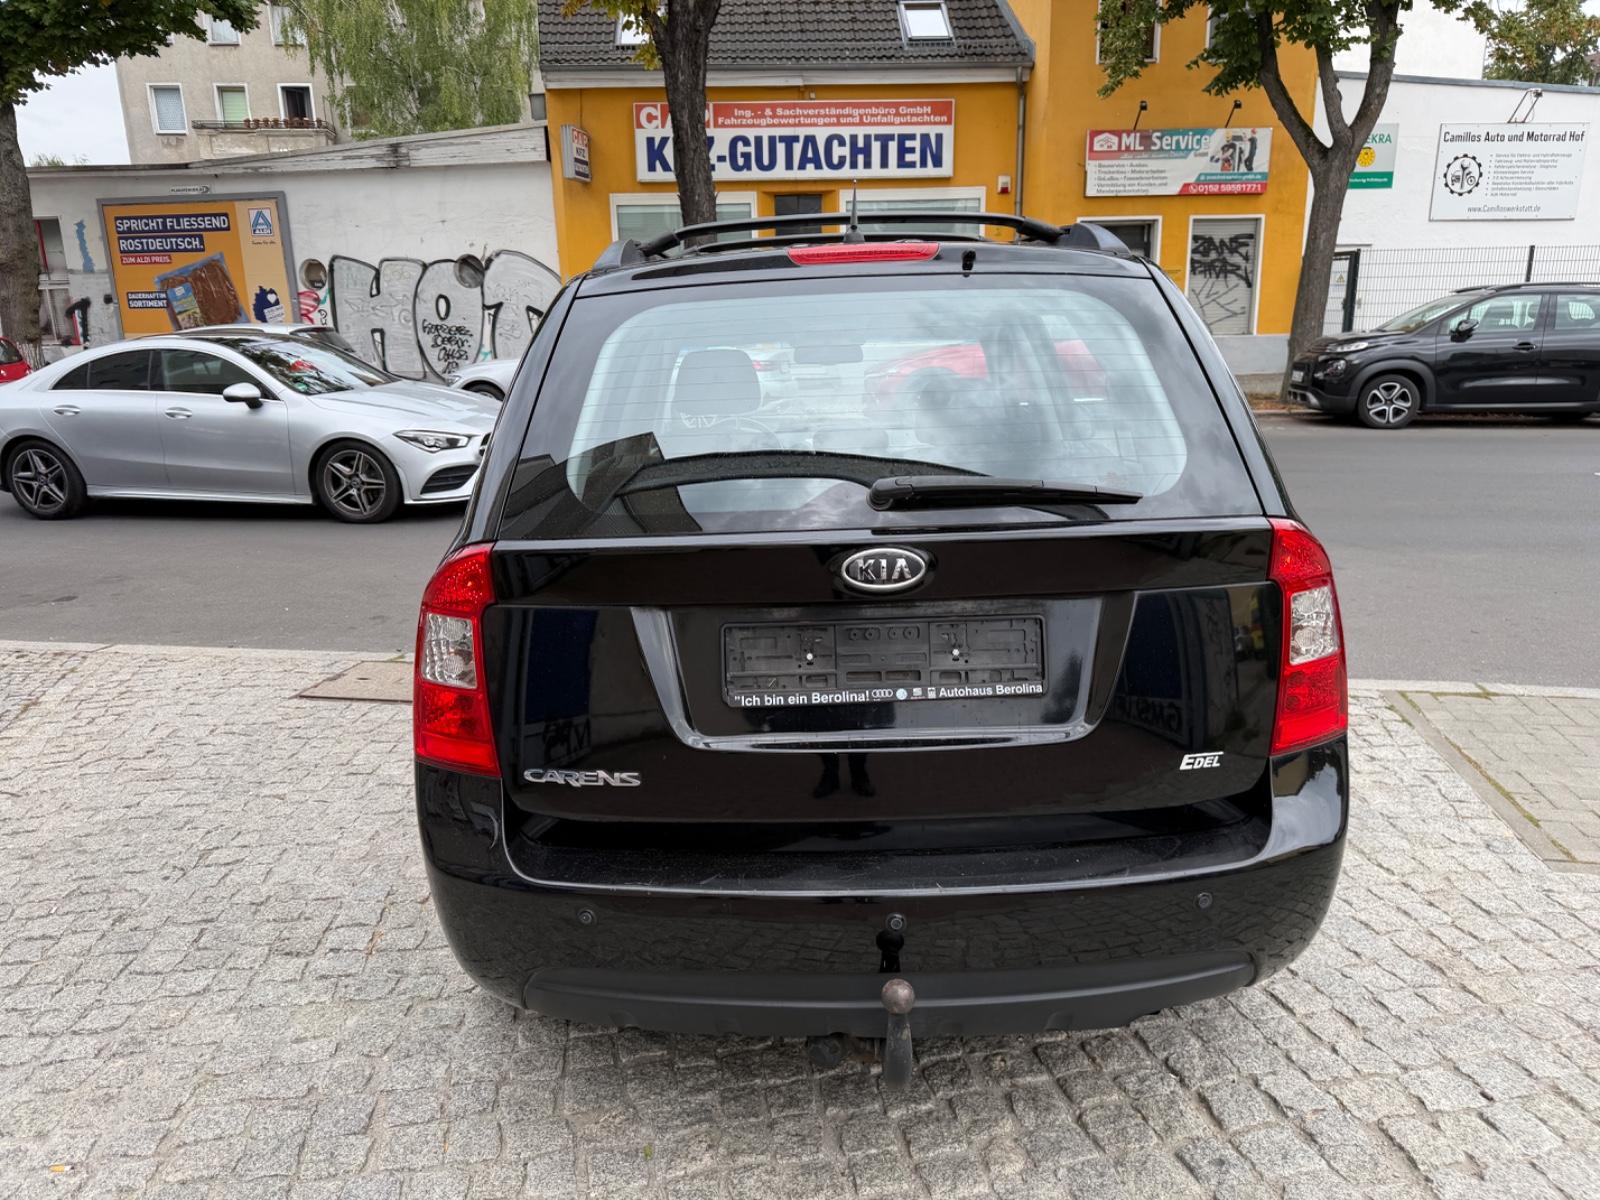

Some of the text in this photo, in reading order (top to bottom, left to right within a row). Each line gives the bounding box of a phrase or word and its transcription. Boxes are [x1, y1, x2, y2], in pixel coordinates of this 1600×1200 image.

[717, 115, 837, 126] Fahrzeugbewertungen
[839, 115, 860, 123] und
[863, 114, 948, 124] Unfallgutachten
[734, 108, 754, 117] Ing.
[765, 108, 773, 116] &
[776, 107, 896, 118] Sachverständigenbüro
[899, 106, 931, 115] GmbH
[1121, 132, 1211, 150] ML Service
[1443, 130, 1585, 143] Camillos Auto und Motorrad Hof
[646, 133, 943, 172] K-GUTACHTEN
[116, 215, 228, 232] SPRICHT FLIESSEND
[119, 237, 204, 251] ROSTDEUTSCH.
[857, 558, 912, 580] KIA
[764, 694, 784, 705] bin
[788, 693, 807, 704] ein
[811, 690, 870, 704] Berolina!
[939, 685, 993, 698] Autohaus
[995, 683, 1043, 696] Berolina
[1179, 751, 1224, 770] EDEL
[523, 768, 641, 788] CARENS
